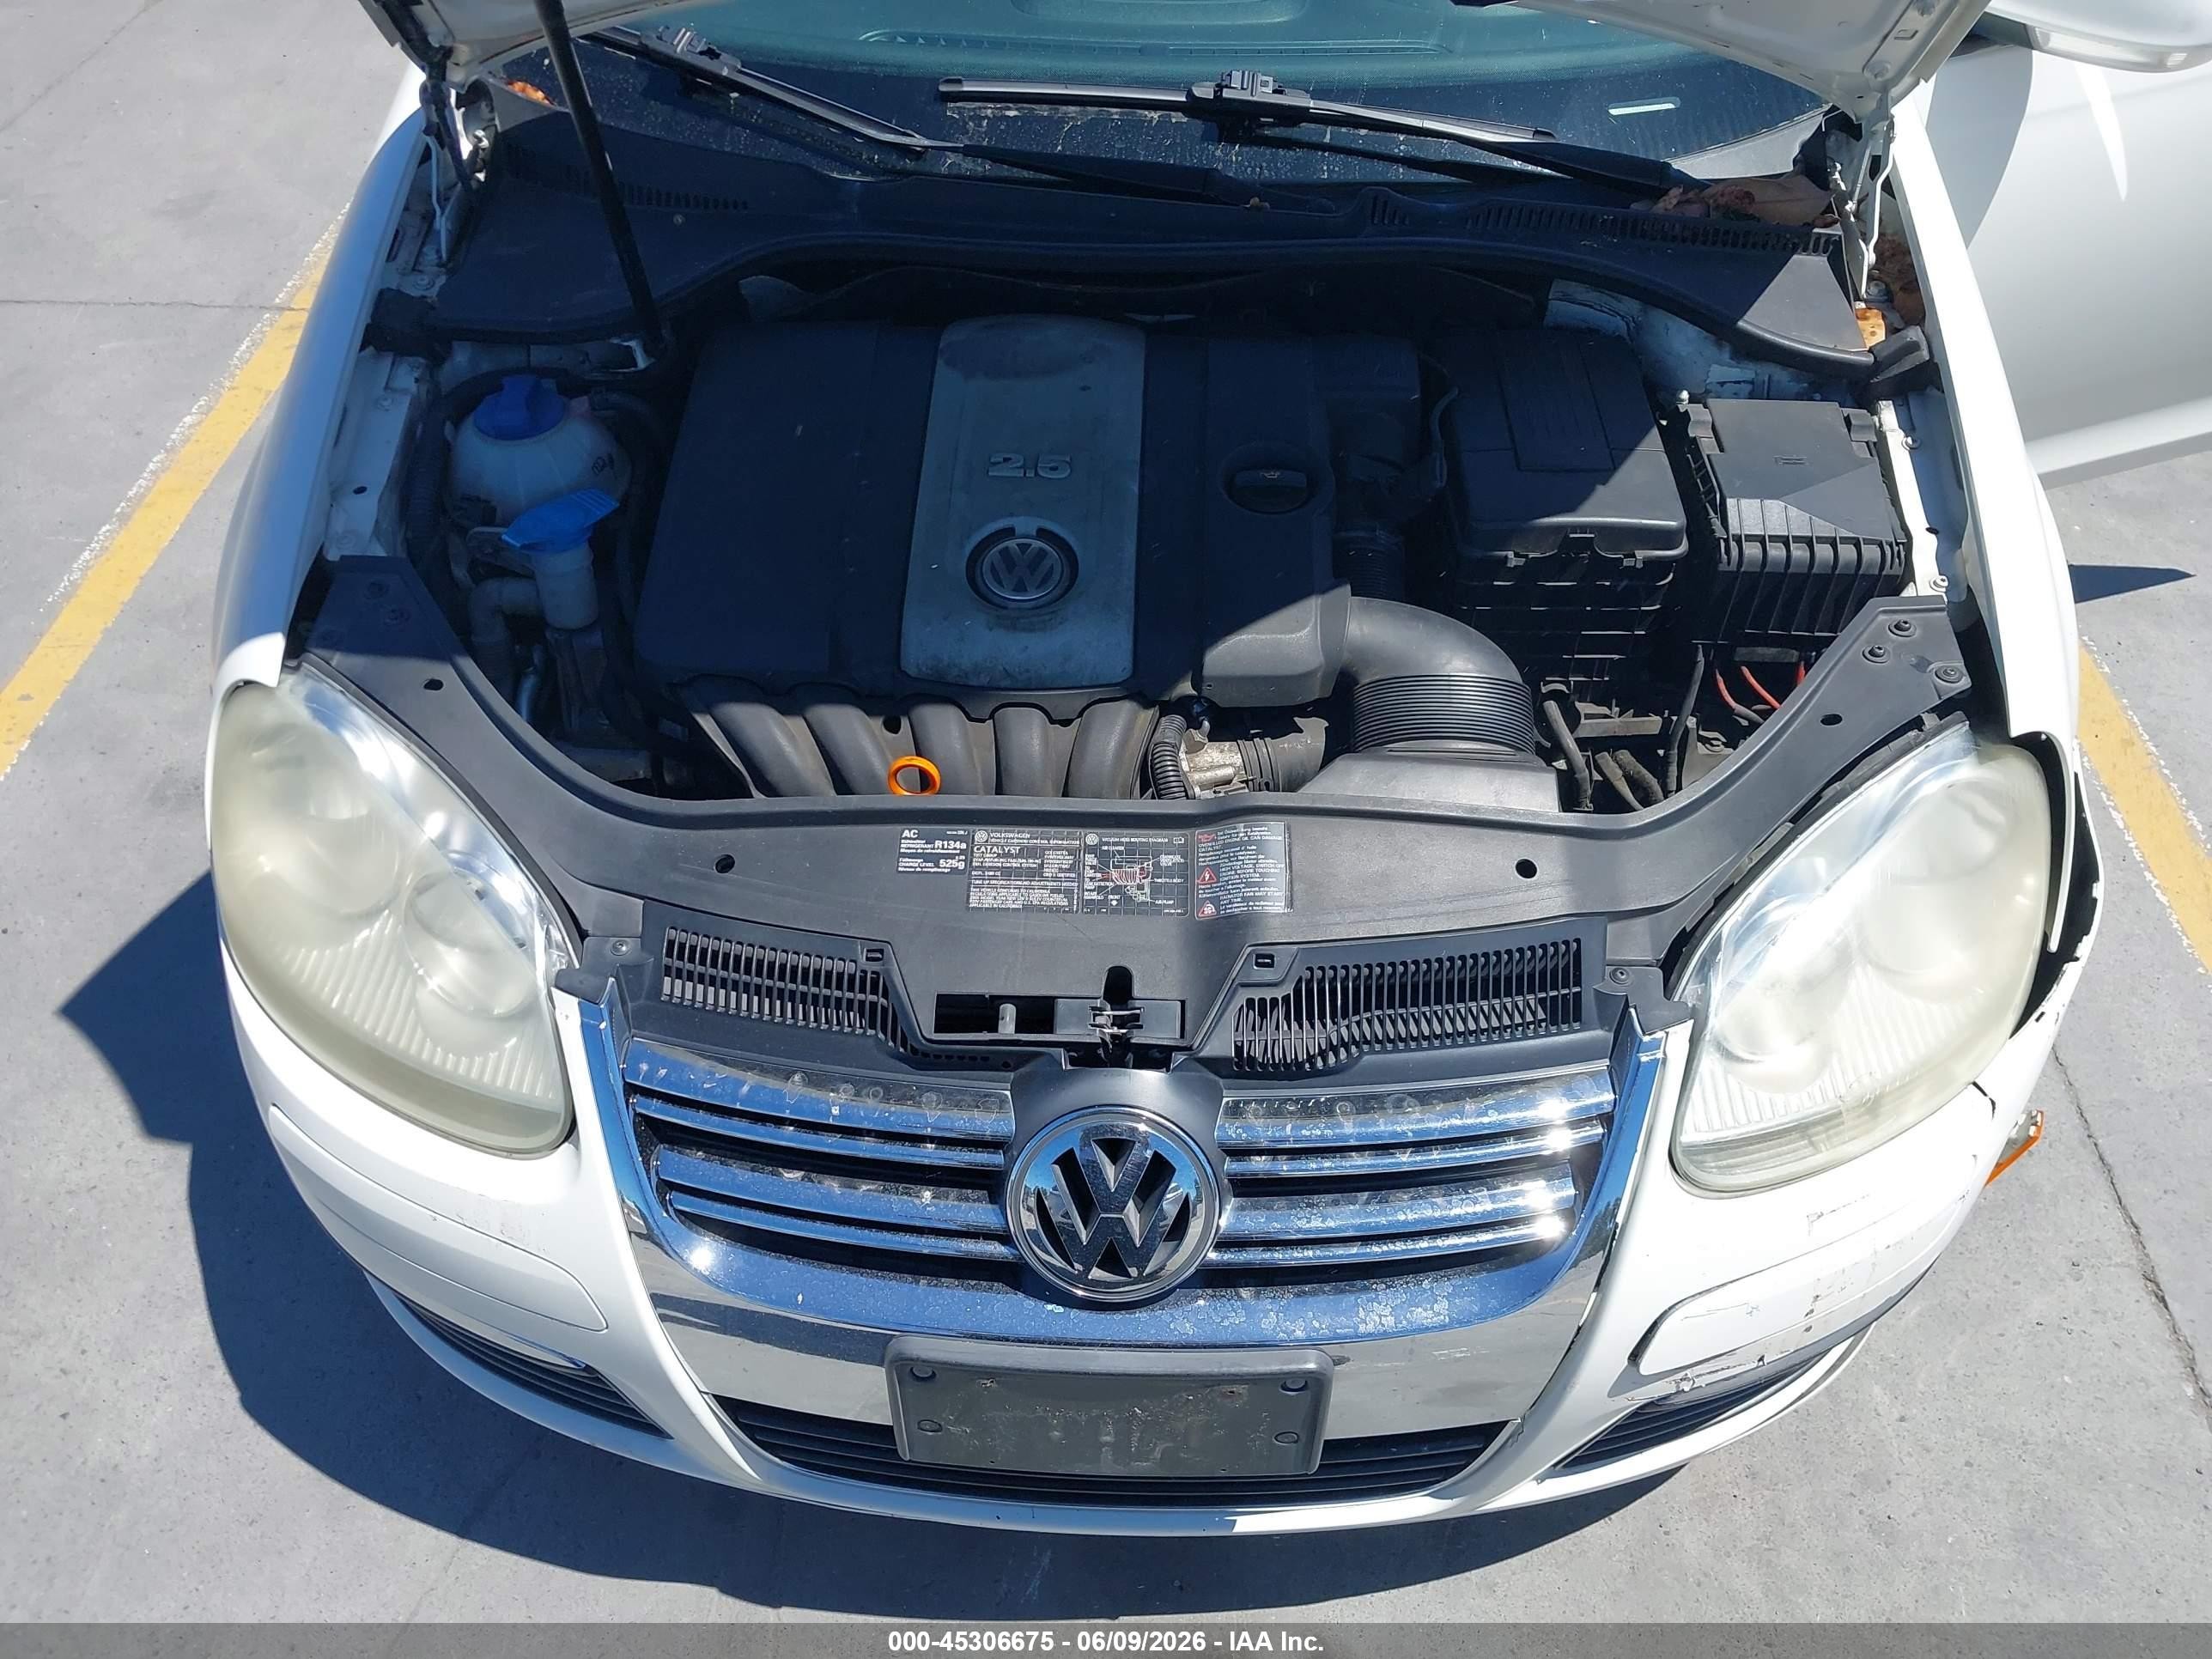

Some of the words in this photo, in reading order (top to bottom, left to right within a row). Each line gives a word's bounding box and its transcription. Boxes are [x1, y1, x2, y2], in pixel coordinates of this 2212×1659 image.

[988, 453, 1072, 478] 2.5
[902, 830, 919, 838] AC
[934, 840, 966, 849] R134a
[939, 859, 965, 869] 525g
